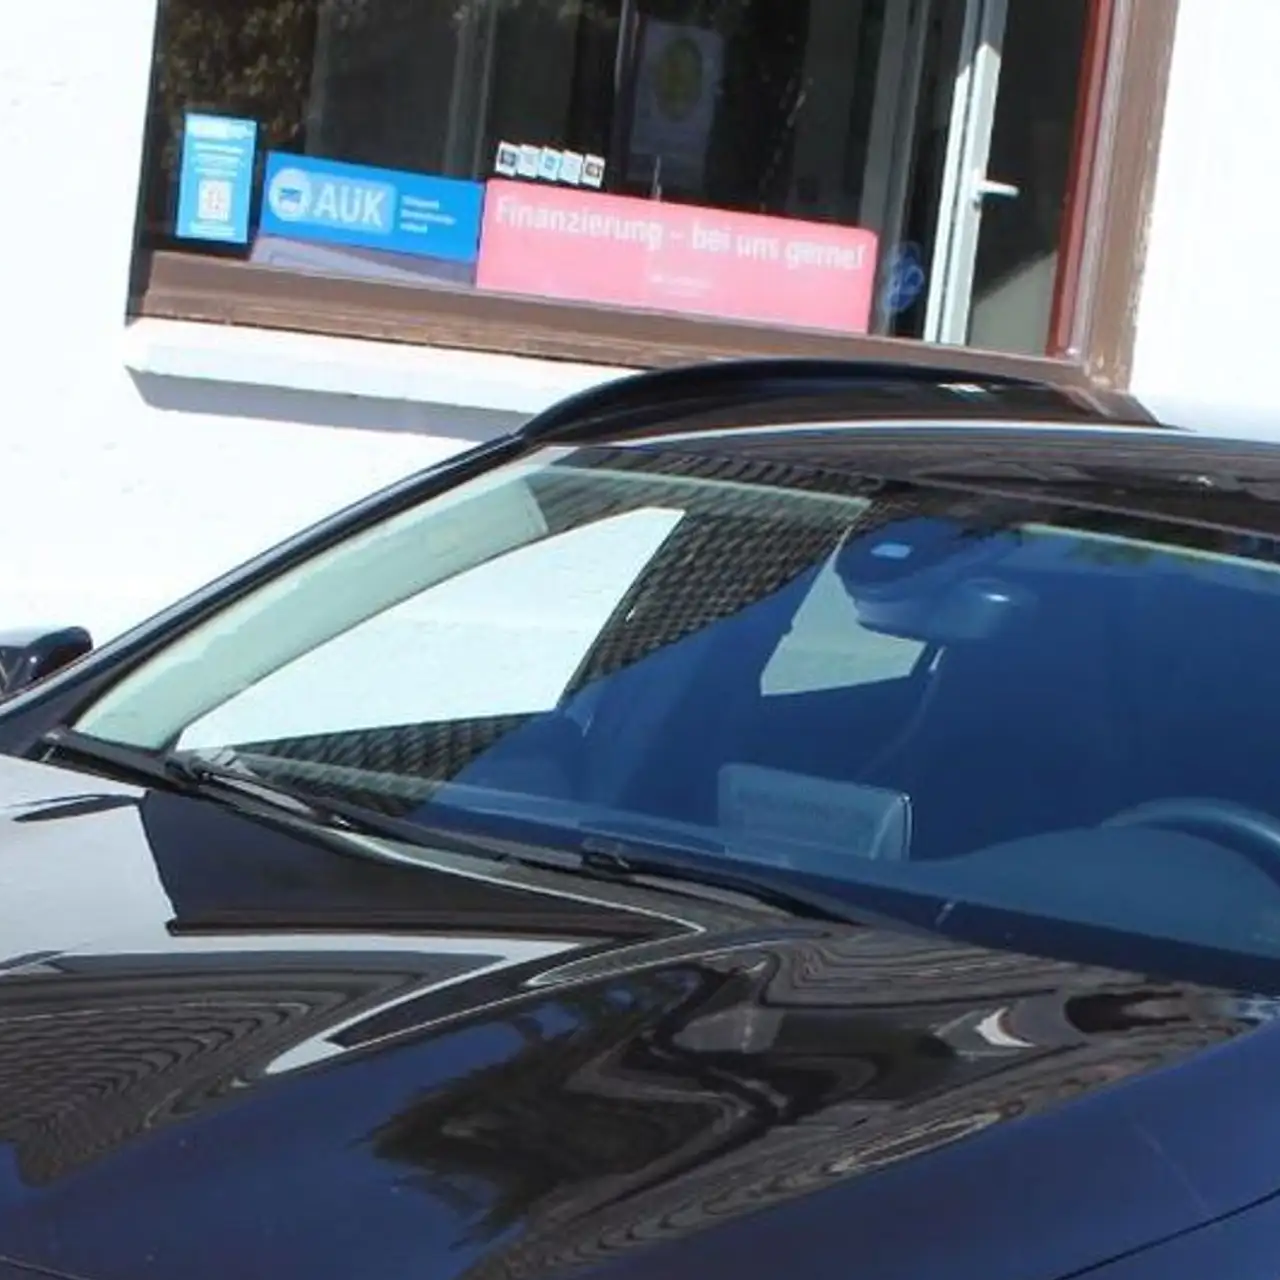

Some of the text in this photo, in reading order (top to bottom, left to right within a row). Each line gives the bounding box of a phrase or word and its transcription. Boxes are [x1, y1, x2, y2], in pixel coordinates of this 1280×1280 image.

[315, 183, 386, 228] AUK
[495, 196, 663, 250] Finanzierung
[691, 222, 731, 255] bei
[735, 235, 779, 262] uns
